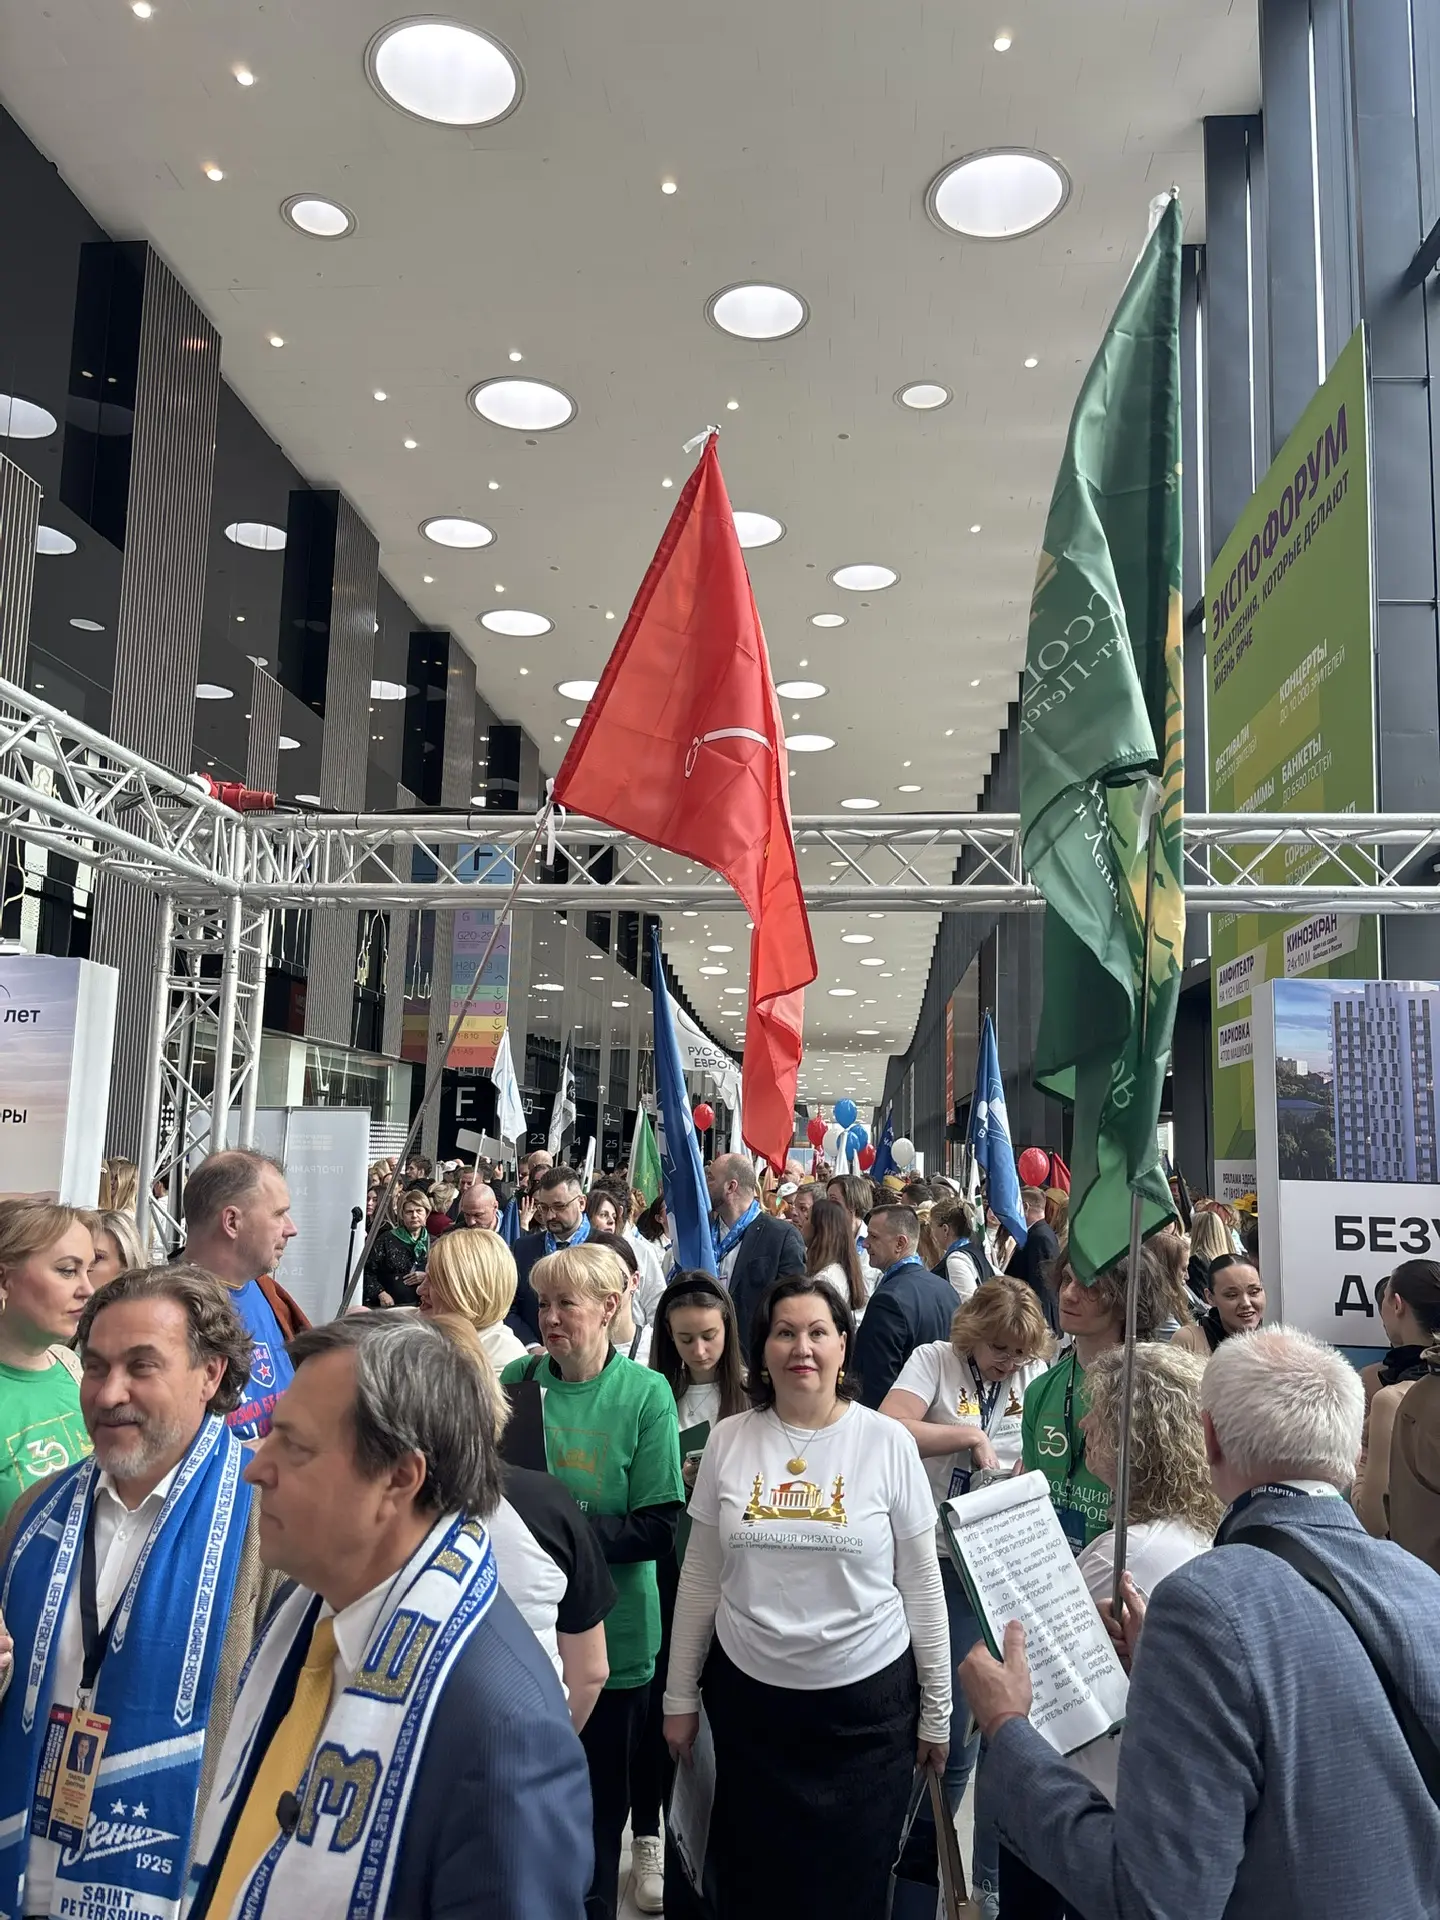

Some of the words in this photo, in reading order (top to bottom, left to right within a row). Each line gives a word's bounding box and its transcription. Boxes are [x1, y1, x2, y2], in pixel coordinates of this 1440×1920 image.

[1212, 403, 1348, 641] ЭКСПОФОРУМ
[1262, 533, 1302, 603] КОТОРЫЕ
[1303, 469, 1349, 553] ДЕЛАЮТ
[1279, 638, 1327, 704] КОНЦЕРТЫ
[1215, 723, 1249, 773] ФЕСТИВАЛИ
[1282, 733, 1322, 785] БАНКЕТЫ
[1286, 913, 1338, 953] КИНОЭКРАН
[1219, 955, 1255, 987] АМФИТЕАТР
[4, 1008, 41, 1023] лет
[1219, 1022, 1251, 1047] ПАРКОВКА
[0, 1109, 27, 1124] РЫ
[456, 1087, 476, 1117] F
[530, 1133, 546, 1145] 23
[605, 1139, 618, 1148] 25
[1335, 1215, 1440, 1255] БЕЗ
[182, 1454, 200, 1477] THE
[193, 1434, 213, 1459] USSR
[62, 1526, 77, 1549] CUP
[728, 1532, 798, 1543] АССОЦИАЦИЯ
[800, 1534, 864, 1547] РИЭЛТОРОВ
[32, 1607, 56, 1661] SUPERCUP
[136, 1852, 172, 1875] 1925
[82, 1885, 135, 1909] SAINT
